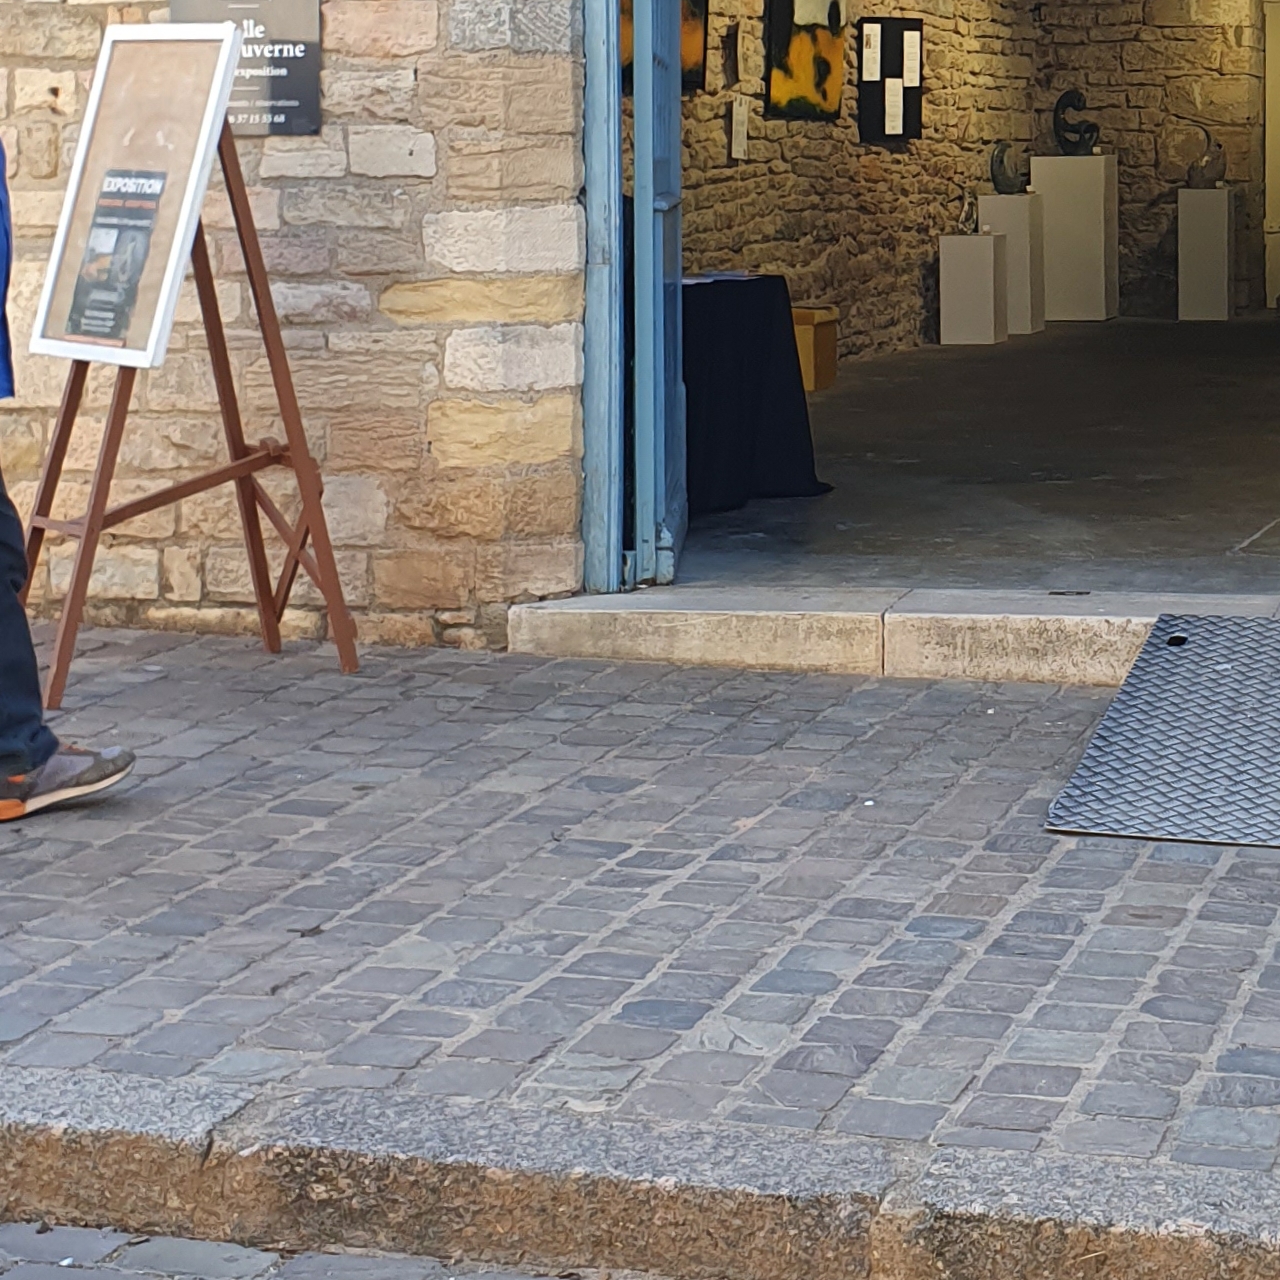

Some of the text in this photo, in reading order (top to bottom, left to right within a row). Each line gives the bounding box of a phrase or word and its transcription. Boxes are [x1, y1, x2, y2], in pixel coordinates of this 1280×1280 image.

[242, 18, 266, 38] lle
[241, 43, 306, 58] uverne
[234, 65, 289, 80] exposition
[102, 177, 164, 195] EXPOSITION
